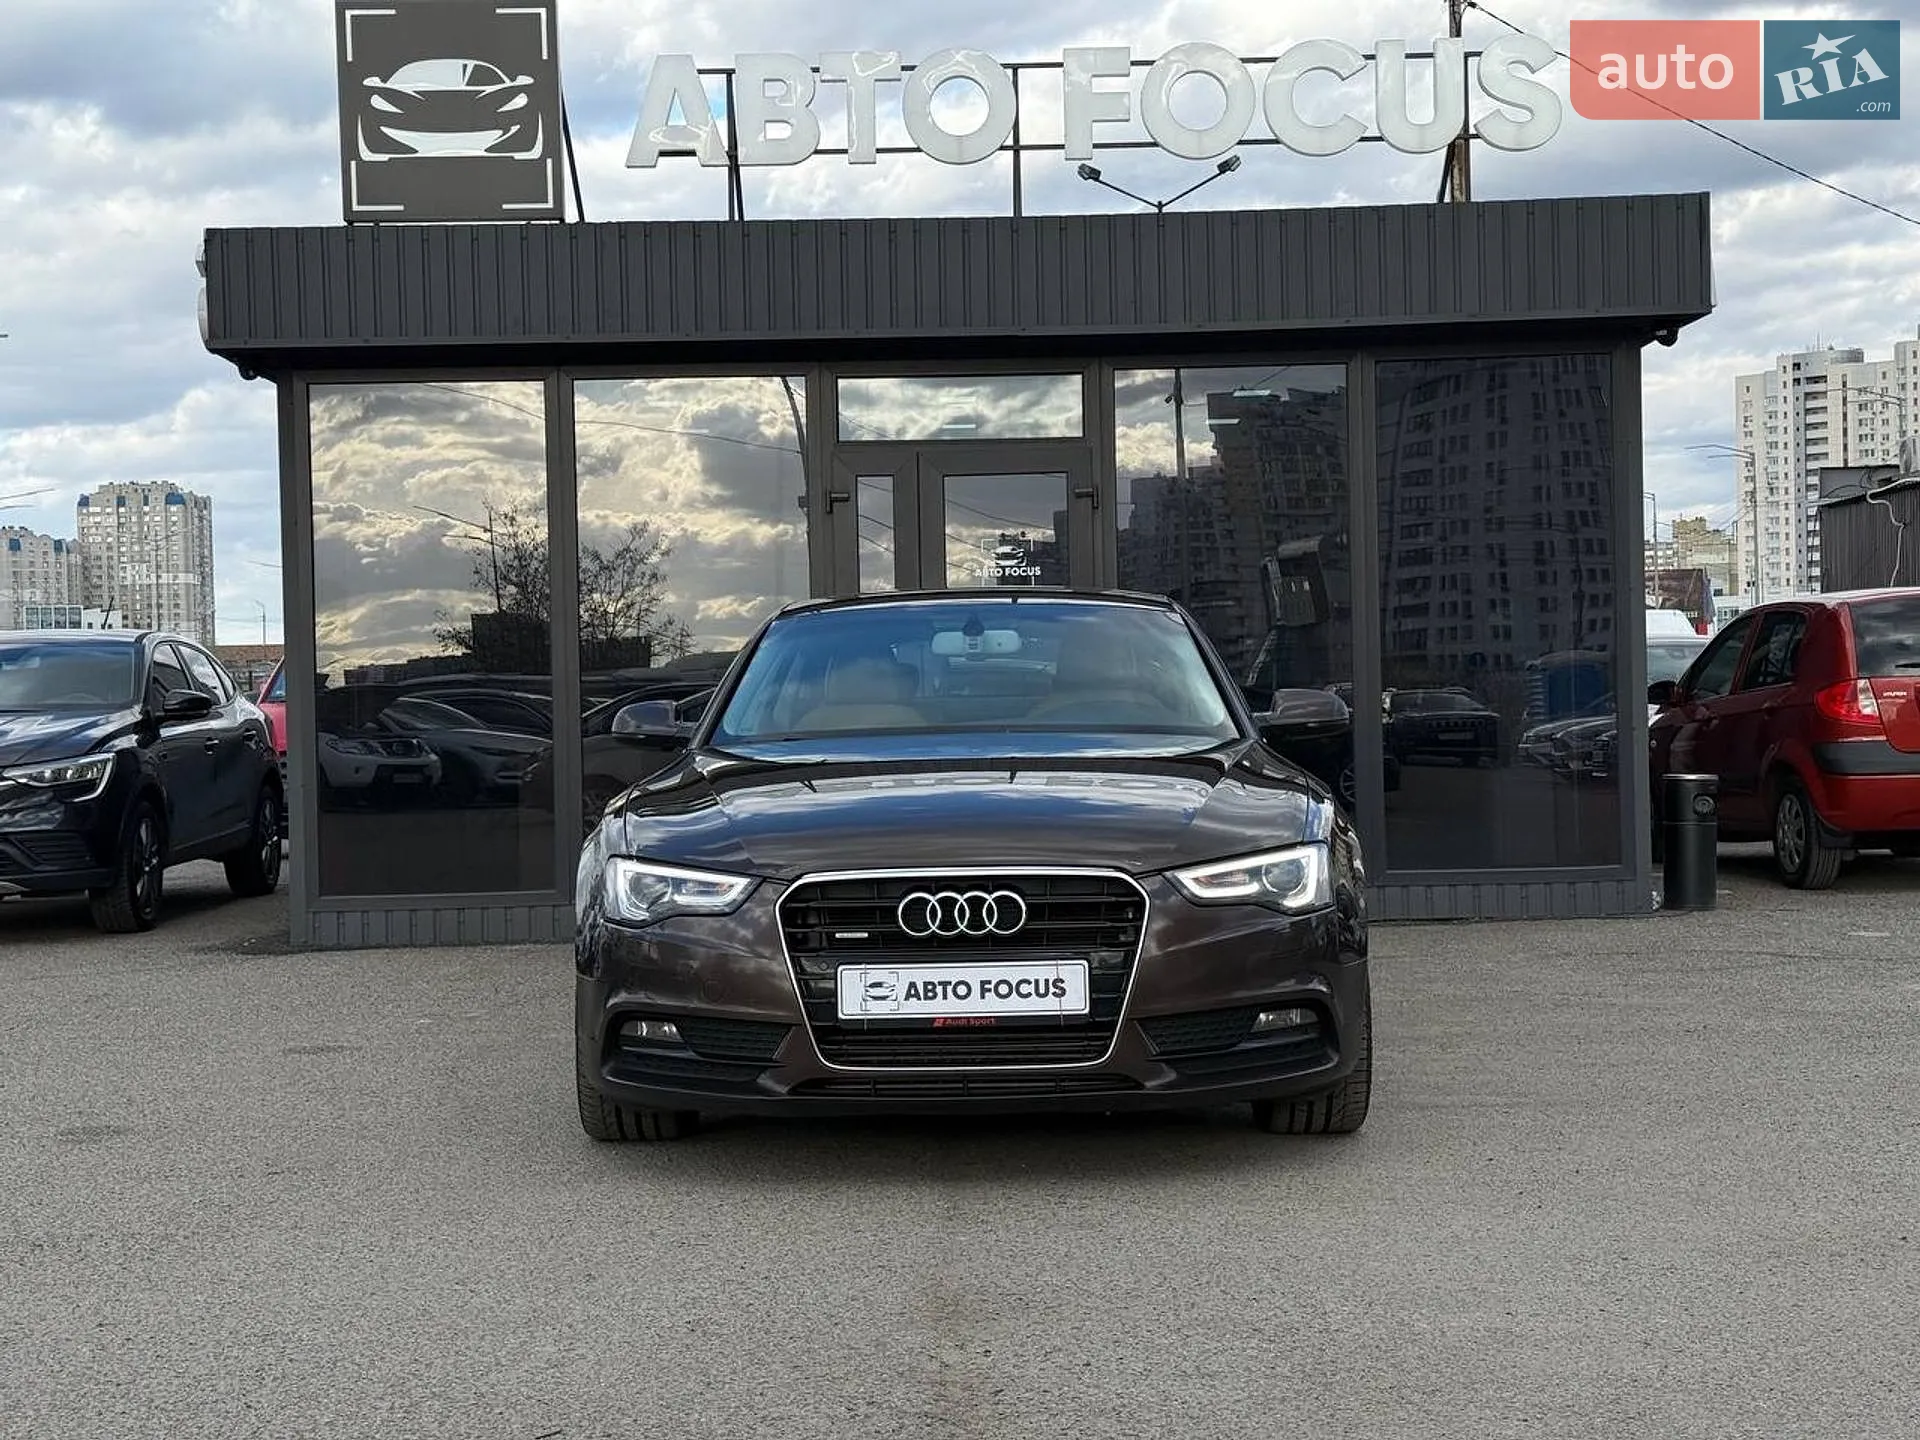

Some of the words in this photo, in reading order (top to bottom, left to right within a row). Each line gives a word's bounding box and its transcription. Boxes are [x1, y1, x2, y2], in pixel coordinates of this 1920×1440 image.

[626, 48, 1017, 168] АВТО
[1063, 34, 1563, 162] FOCUS
[1005, 566, 1041, 576] FOCUS
[904, 980, 972, 1001] АВТО
[980, 978, 1067, 1000] FOCUS
